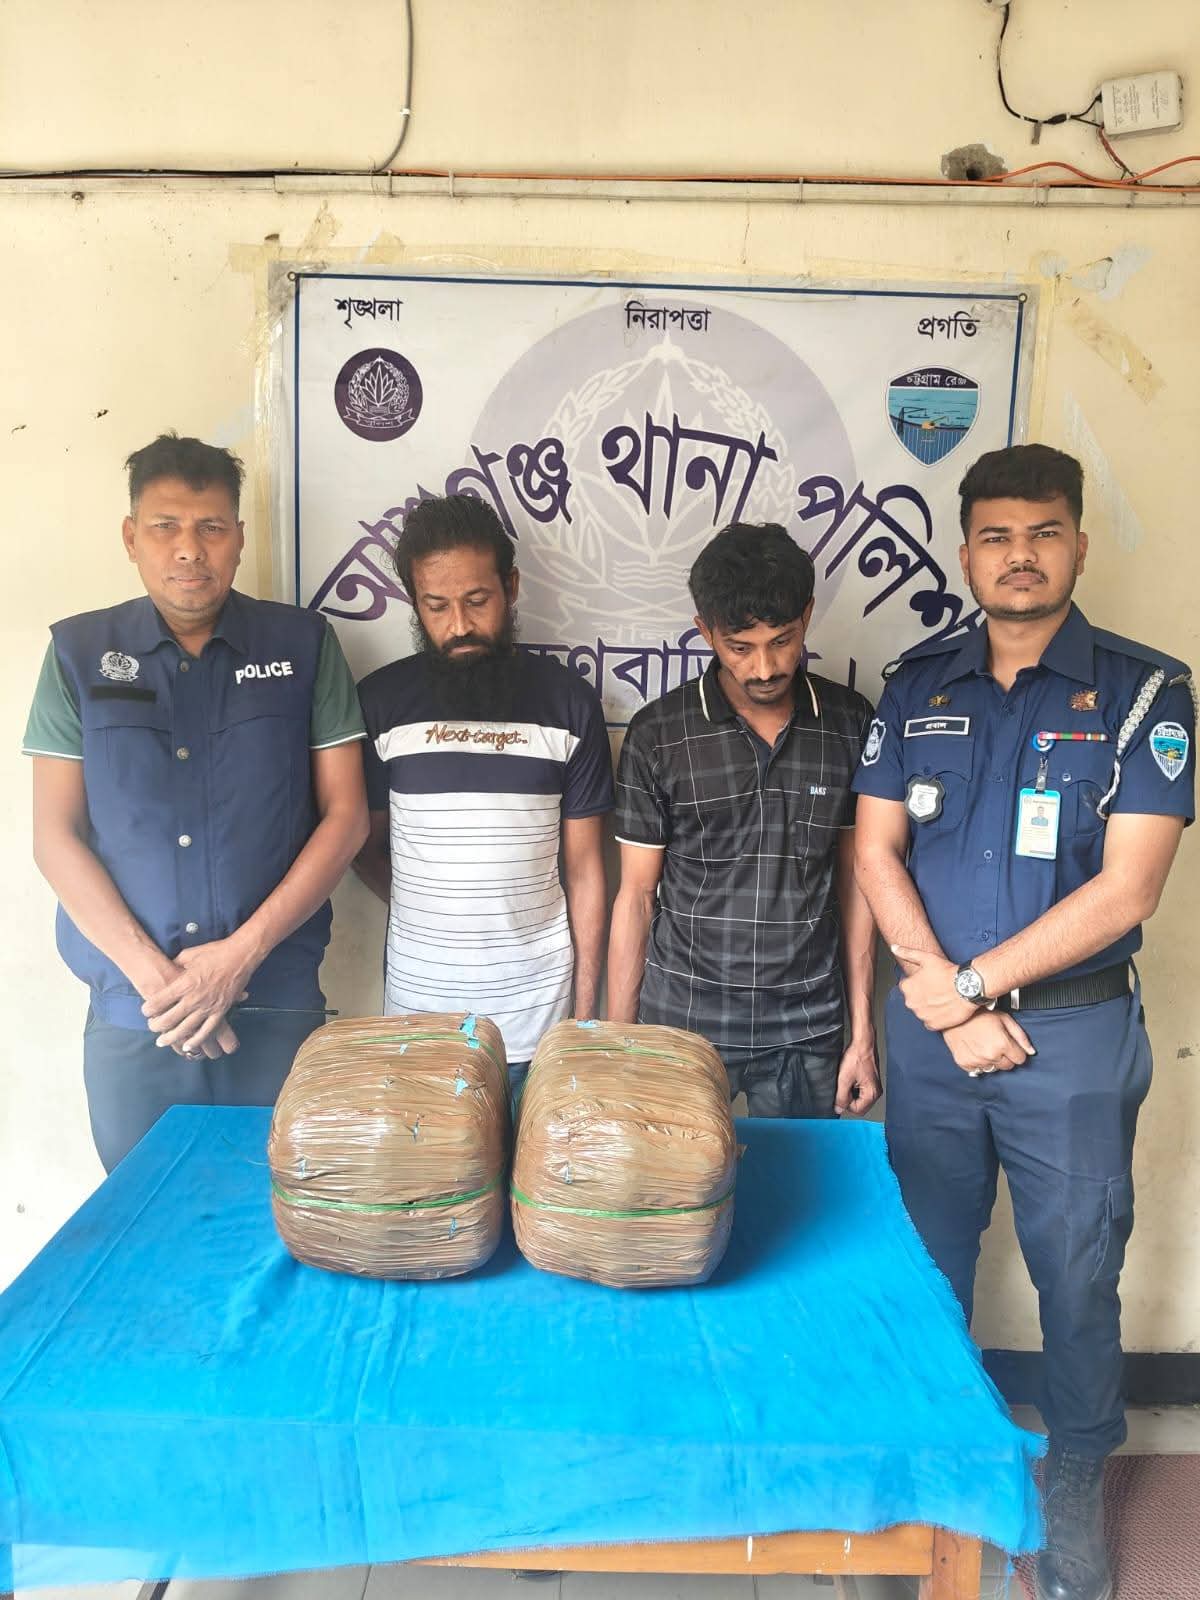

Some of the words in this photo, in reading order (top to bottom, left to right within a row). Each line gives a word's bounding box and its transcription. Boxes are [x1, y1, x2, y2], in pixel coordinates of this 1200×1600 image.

[624, 300, 712, 332] নিরাপত্তা
[917, 310, 980, 339] প্রগতি
[601, 410, 778, 526] থানা
[797, 475, 983, 655] পলিশ
[235, 661, 294, 685] POLICE
